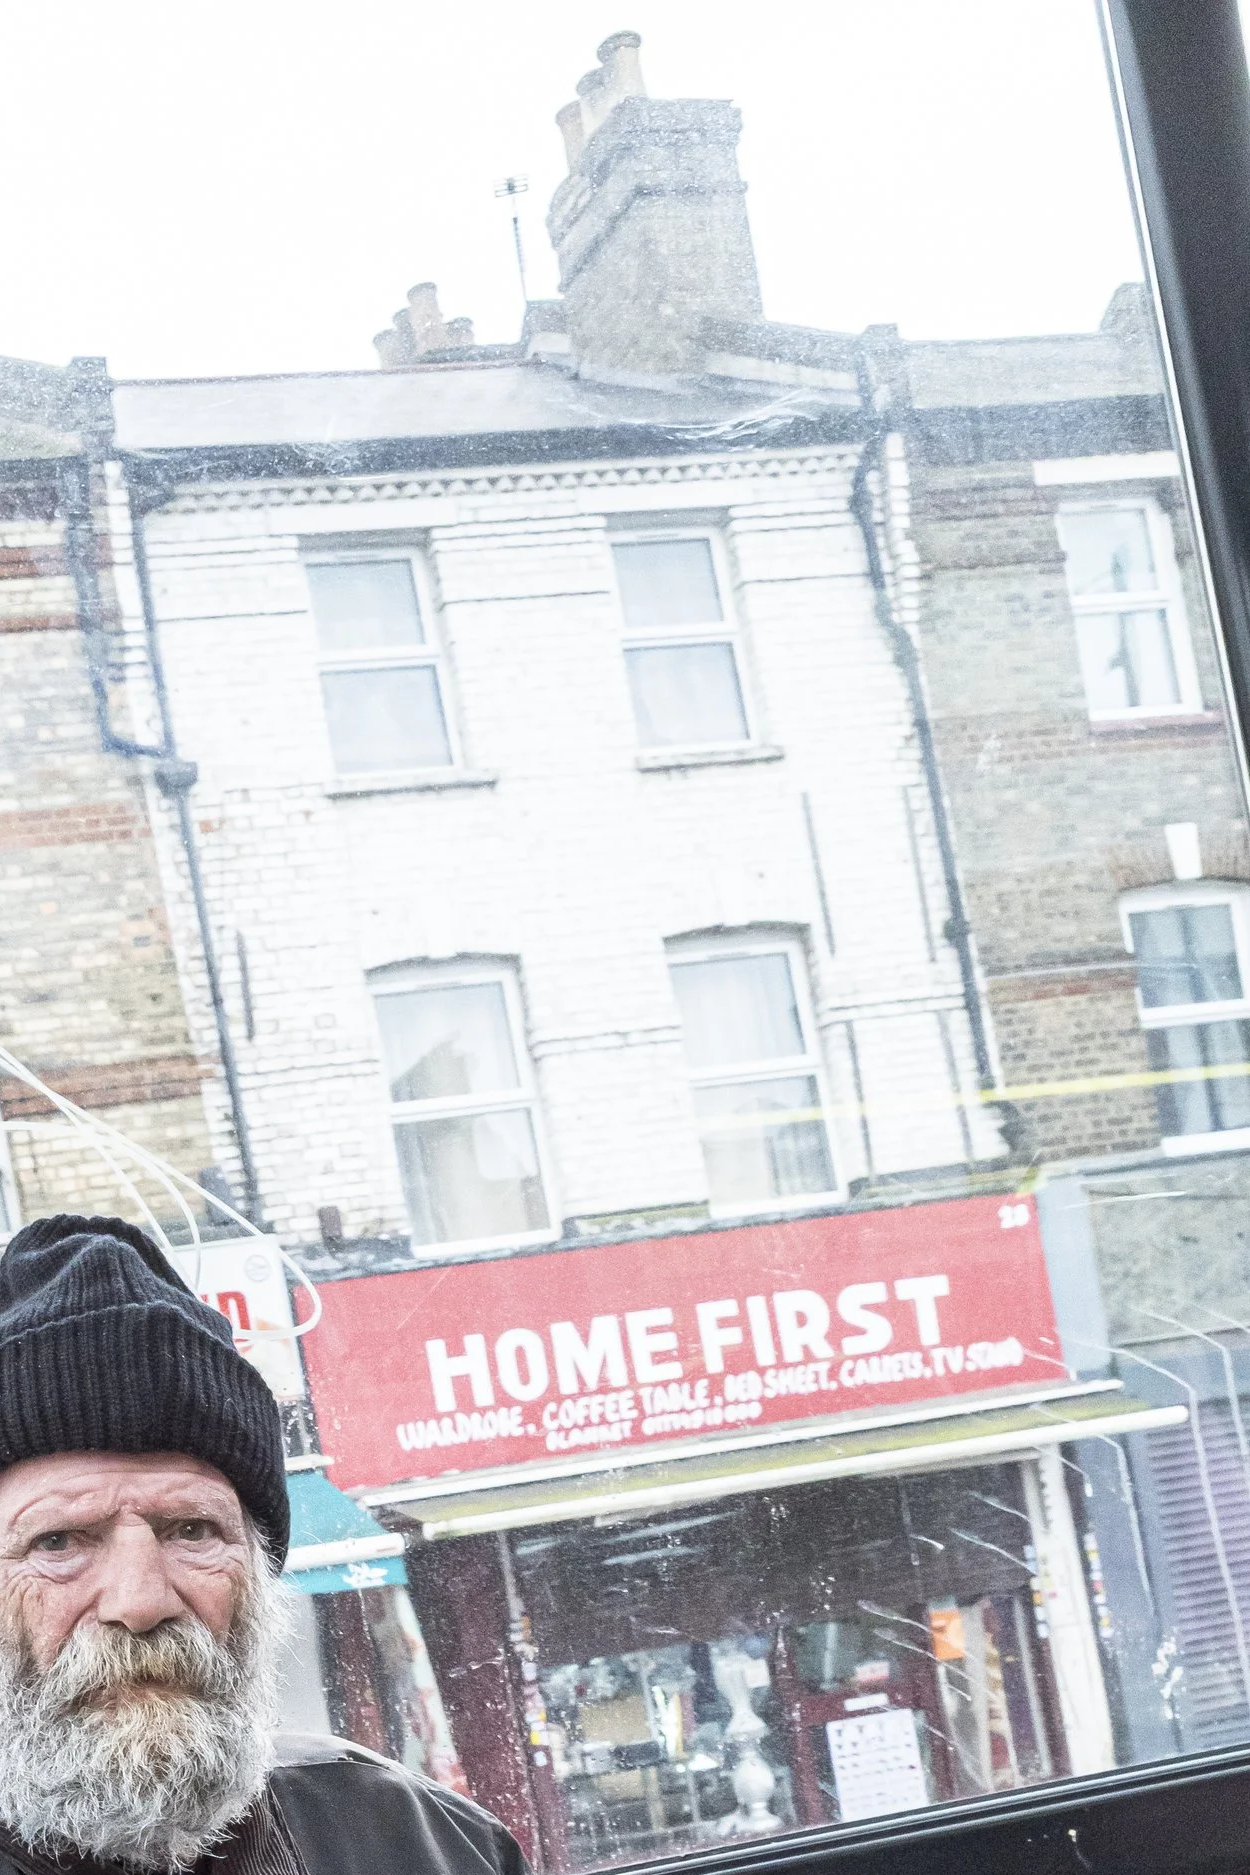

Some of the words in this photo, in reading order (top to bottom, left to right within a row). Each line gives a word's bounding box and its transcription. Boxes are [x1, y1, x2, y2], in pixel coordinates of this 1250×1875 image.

[425, 1307, 683, 1412] HOME
[695, 1275, 951, 1373] FIRST
[543, 1391, 639, 1430] COFFEE
